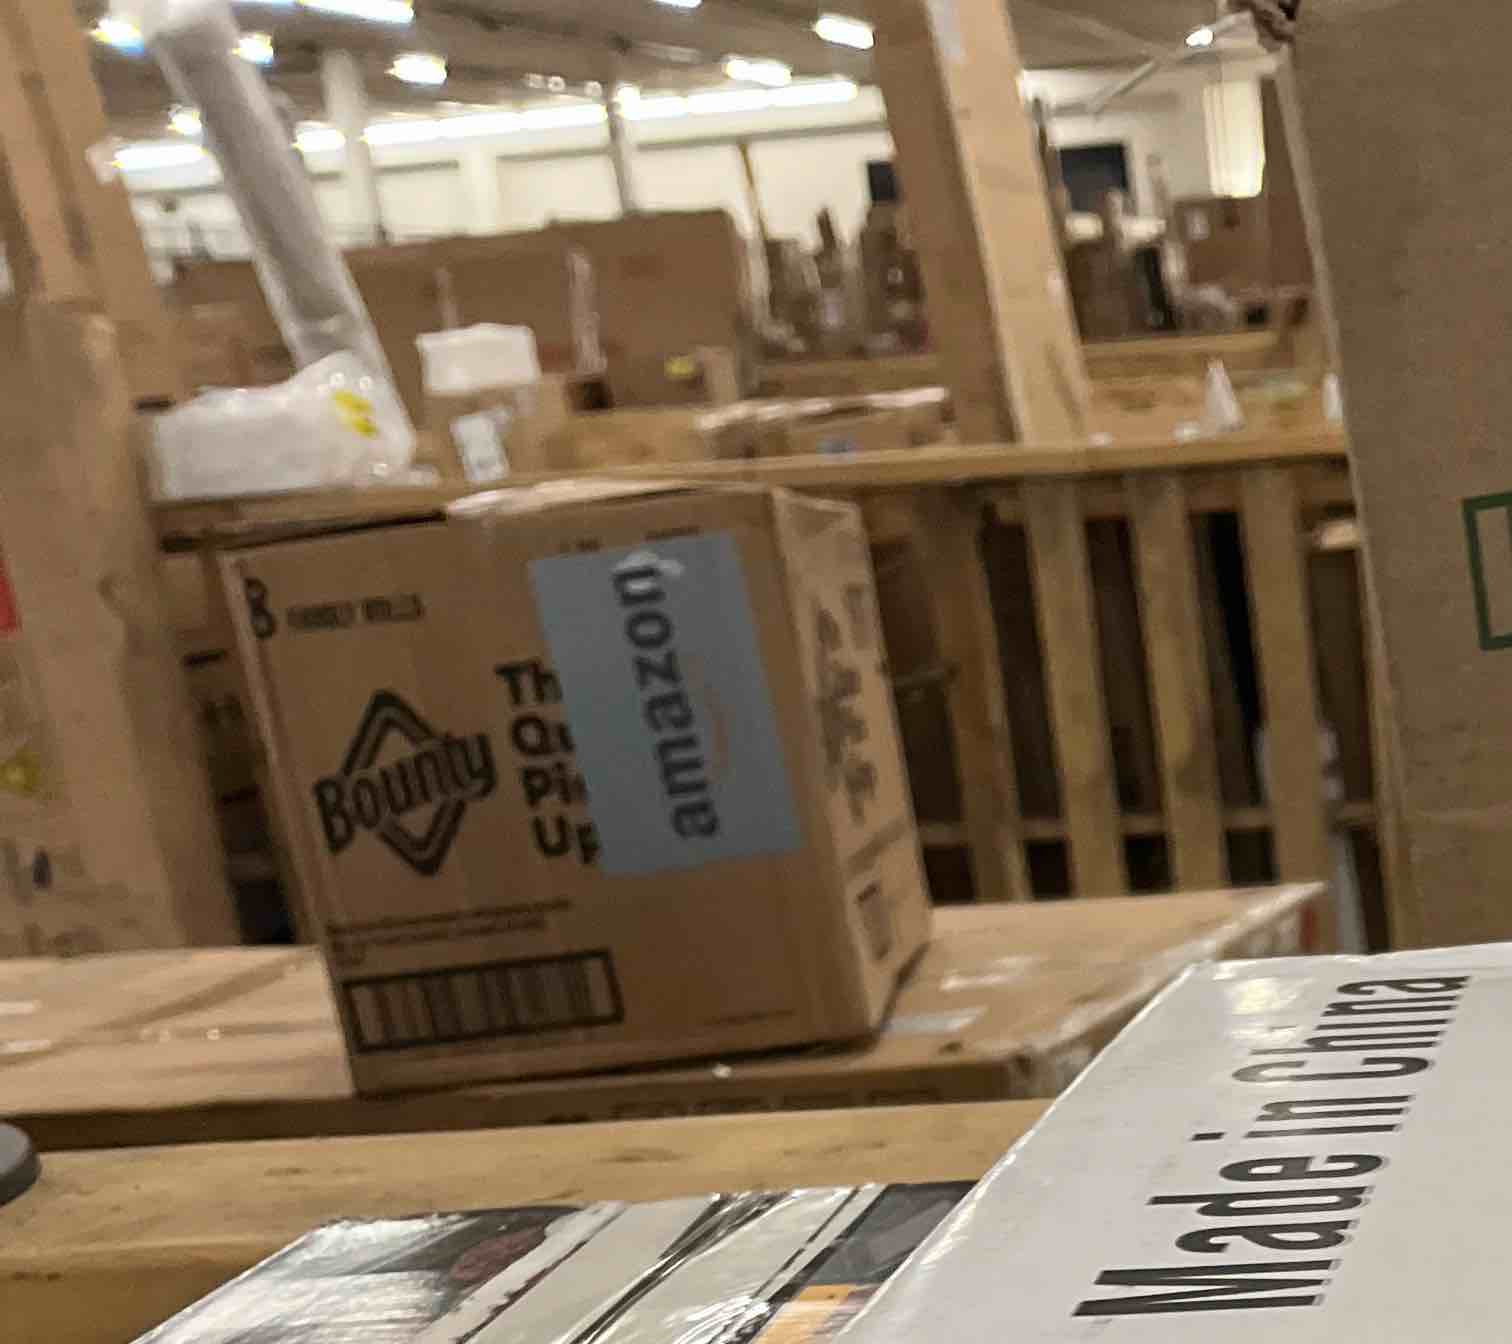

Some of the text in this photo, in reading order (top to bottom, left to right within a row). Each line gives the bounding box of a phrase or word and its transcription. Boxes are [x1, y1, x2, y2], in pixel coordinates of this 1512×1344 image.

[313, 732, 496, 856] Bounty
[612, 560, 720, 840] amazon
[1071, 975, 1472, 1317] Made in China
